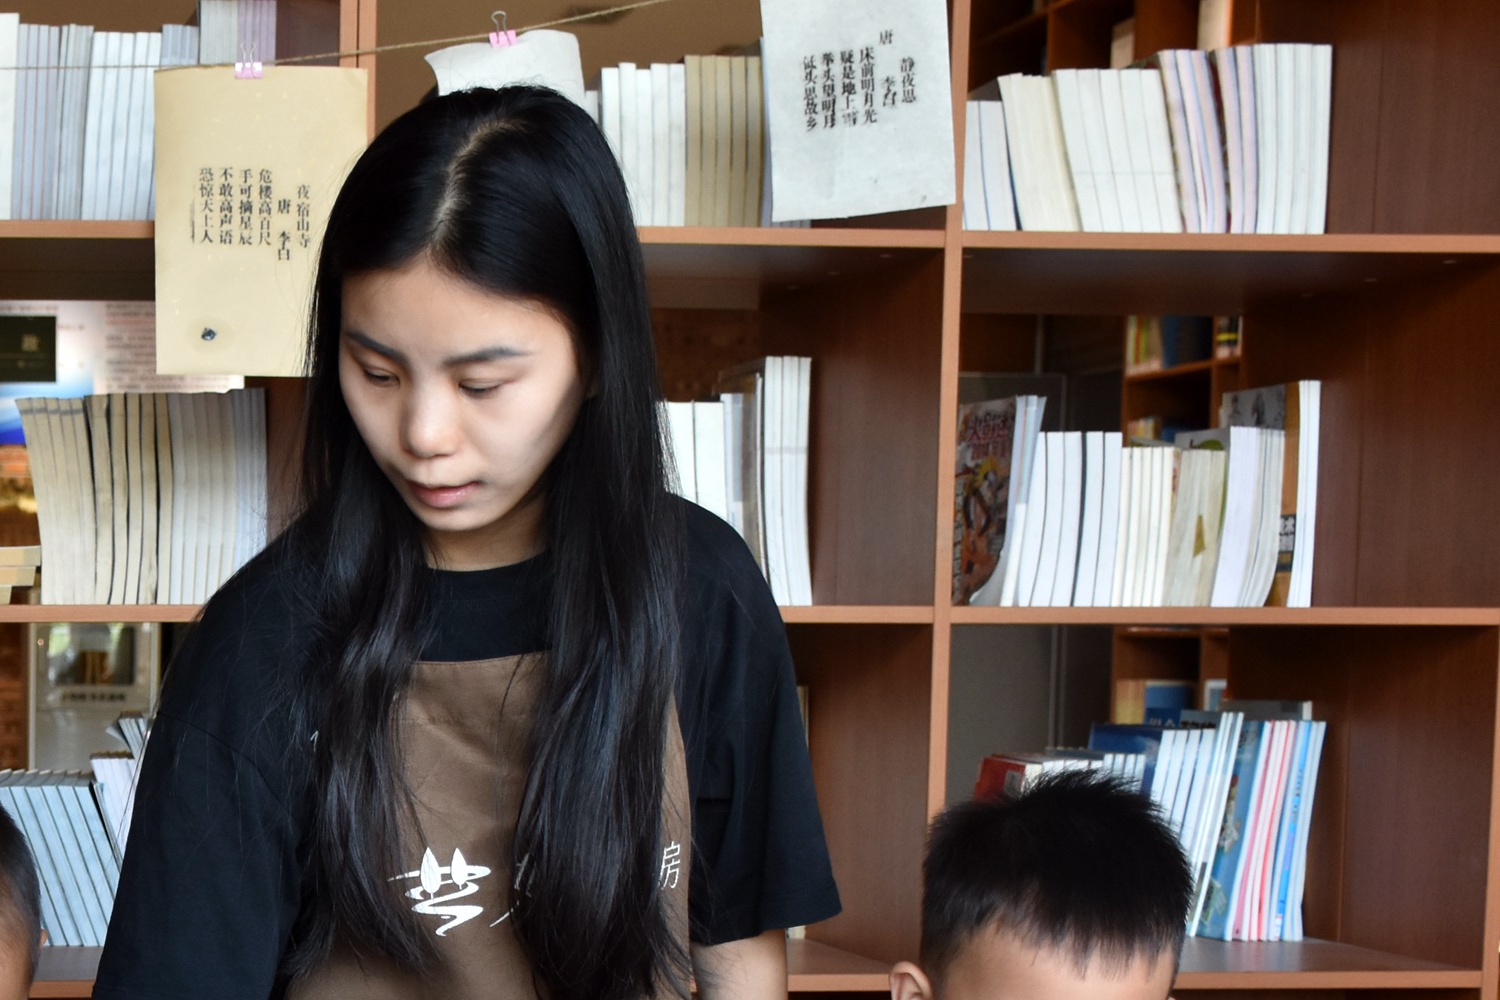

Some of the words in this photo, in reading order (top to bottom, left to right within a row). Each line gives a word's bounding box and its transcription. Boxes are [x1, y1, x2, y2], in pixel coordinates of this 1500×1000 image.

[879, 29, 894, 45] 唐
[859, 46, 878, 125] 床前明月光
[199, 167, 214, 244] 恐惊天上人
[219, 166, 233, 245] 不敢高声语
[238, 168, 253, 246] 手可摘星辰
[258, 168, 272, 246] 危楼高百尺
[277, 199, 291, 214] 唐
[296, 184, 311, 248] 夜宿山寺
[277, 230, 291, 261] 李白
